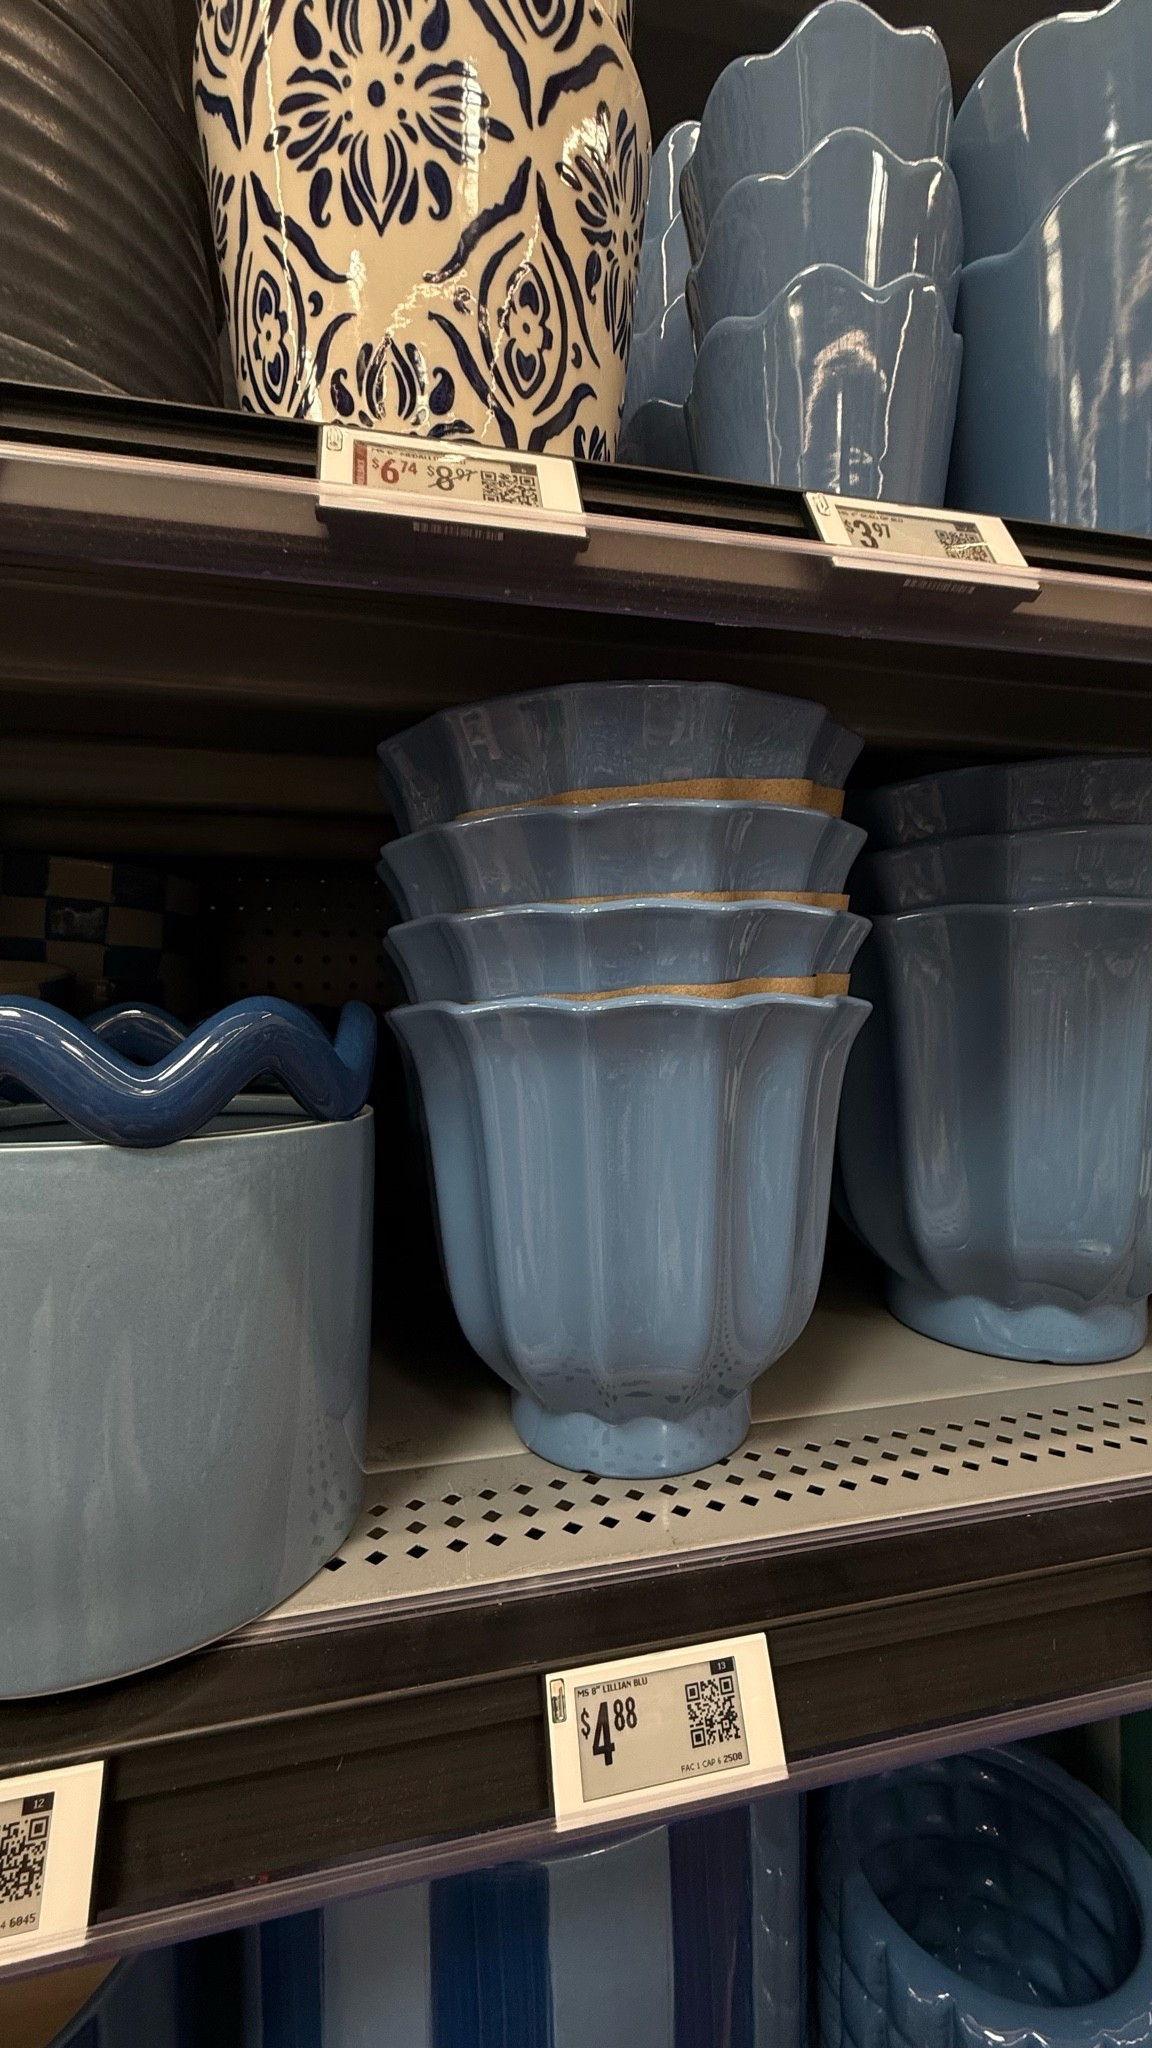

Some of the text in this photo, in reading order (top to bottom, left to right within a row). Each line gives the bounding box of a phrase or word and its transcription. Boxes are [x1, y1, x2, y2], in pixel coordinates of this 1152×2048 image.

[717, 1661, 726, 1670] 13
[577, 1688, 590, 1698] MS
[602, 1680, 632, 1693] LILLIAN
[633, 1676, 648, 1687] BLU
[680, 1762, 695, 1773] FAC
[702, 1758, 716, 1768] CAP
[723, 1751, 743, 1763] 2508
[33, 1798, 45, 1809] 12
